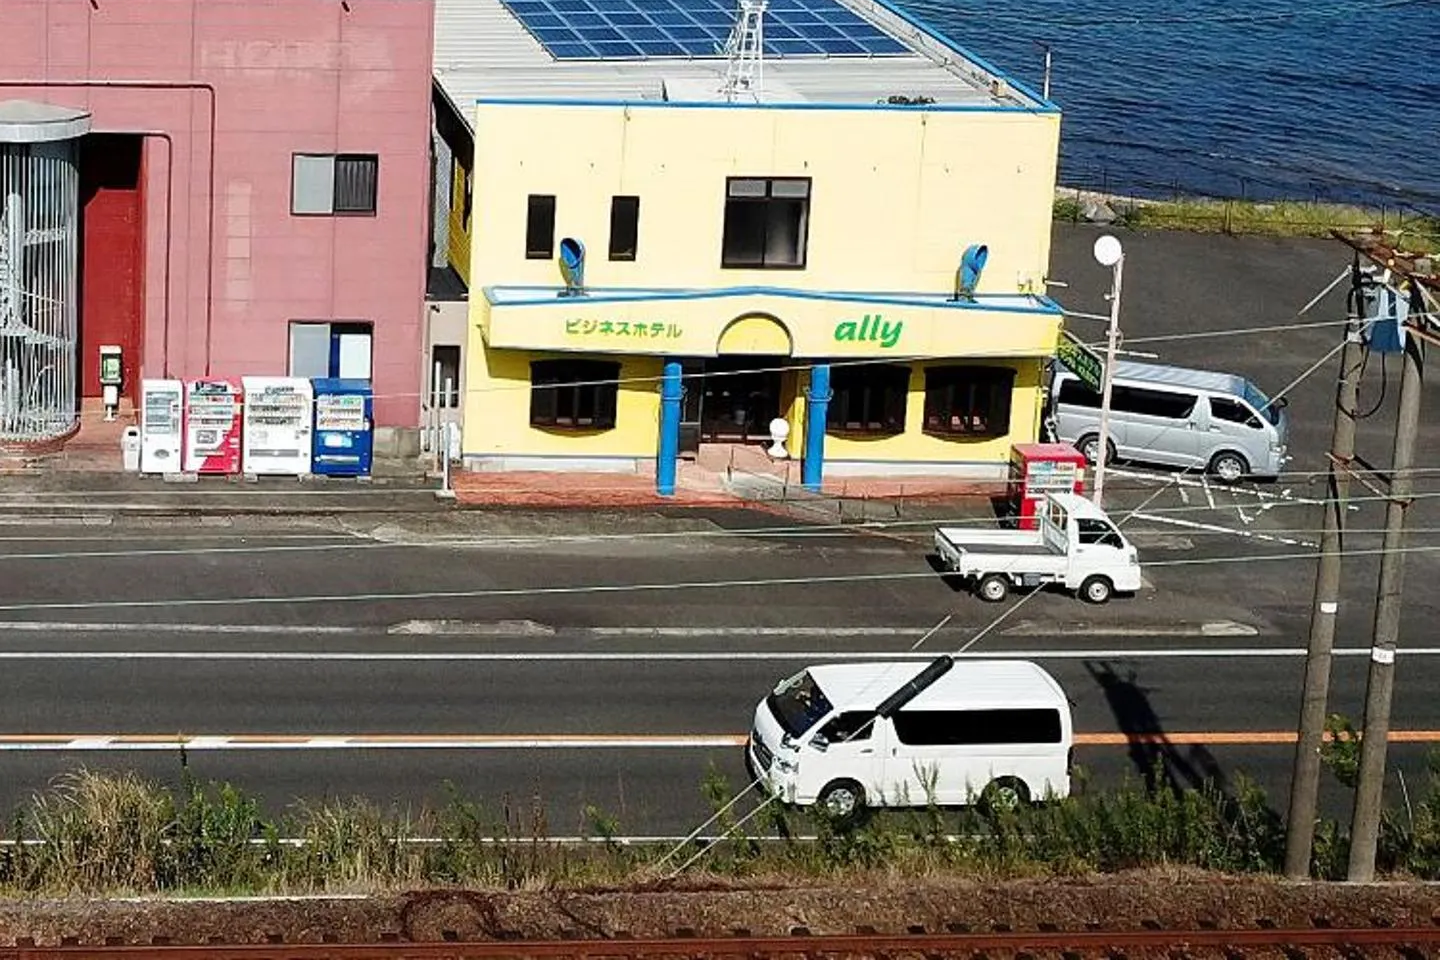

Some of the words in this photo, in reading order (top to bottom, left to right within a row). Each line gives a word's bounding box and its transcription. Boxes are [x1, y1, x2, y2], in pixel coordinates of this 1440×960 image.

[566, 319, 682, 338] ビジネスホテル
[835, 314, 902, 348] ally
